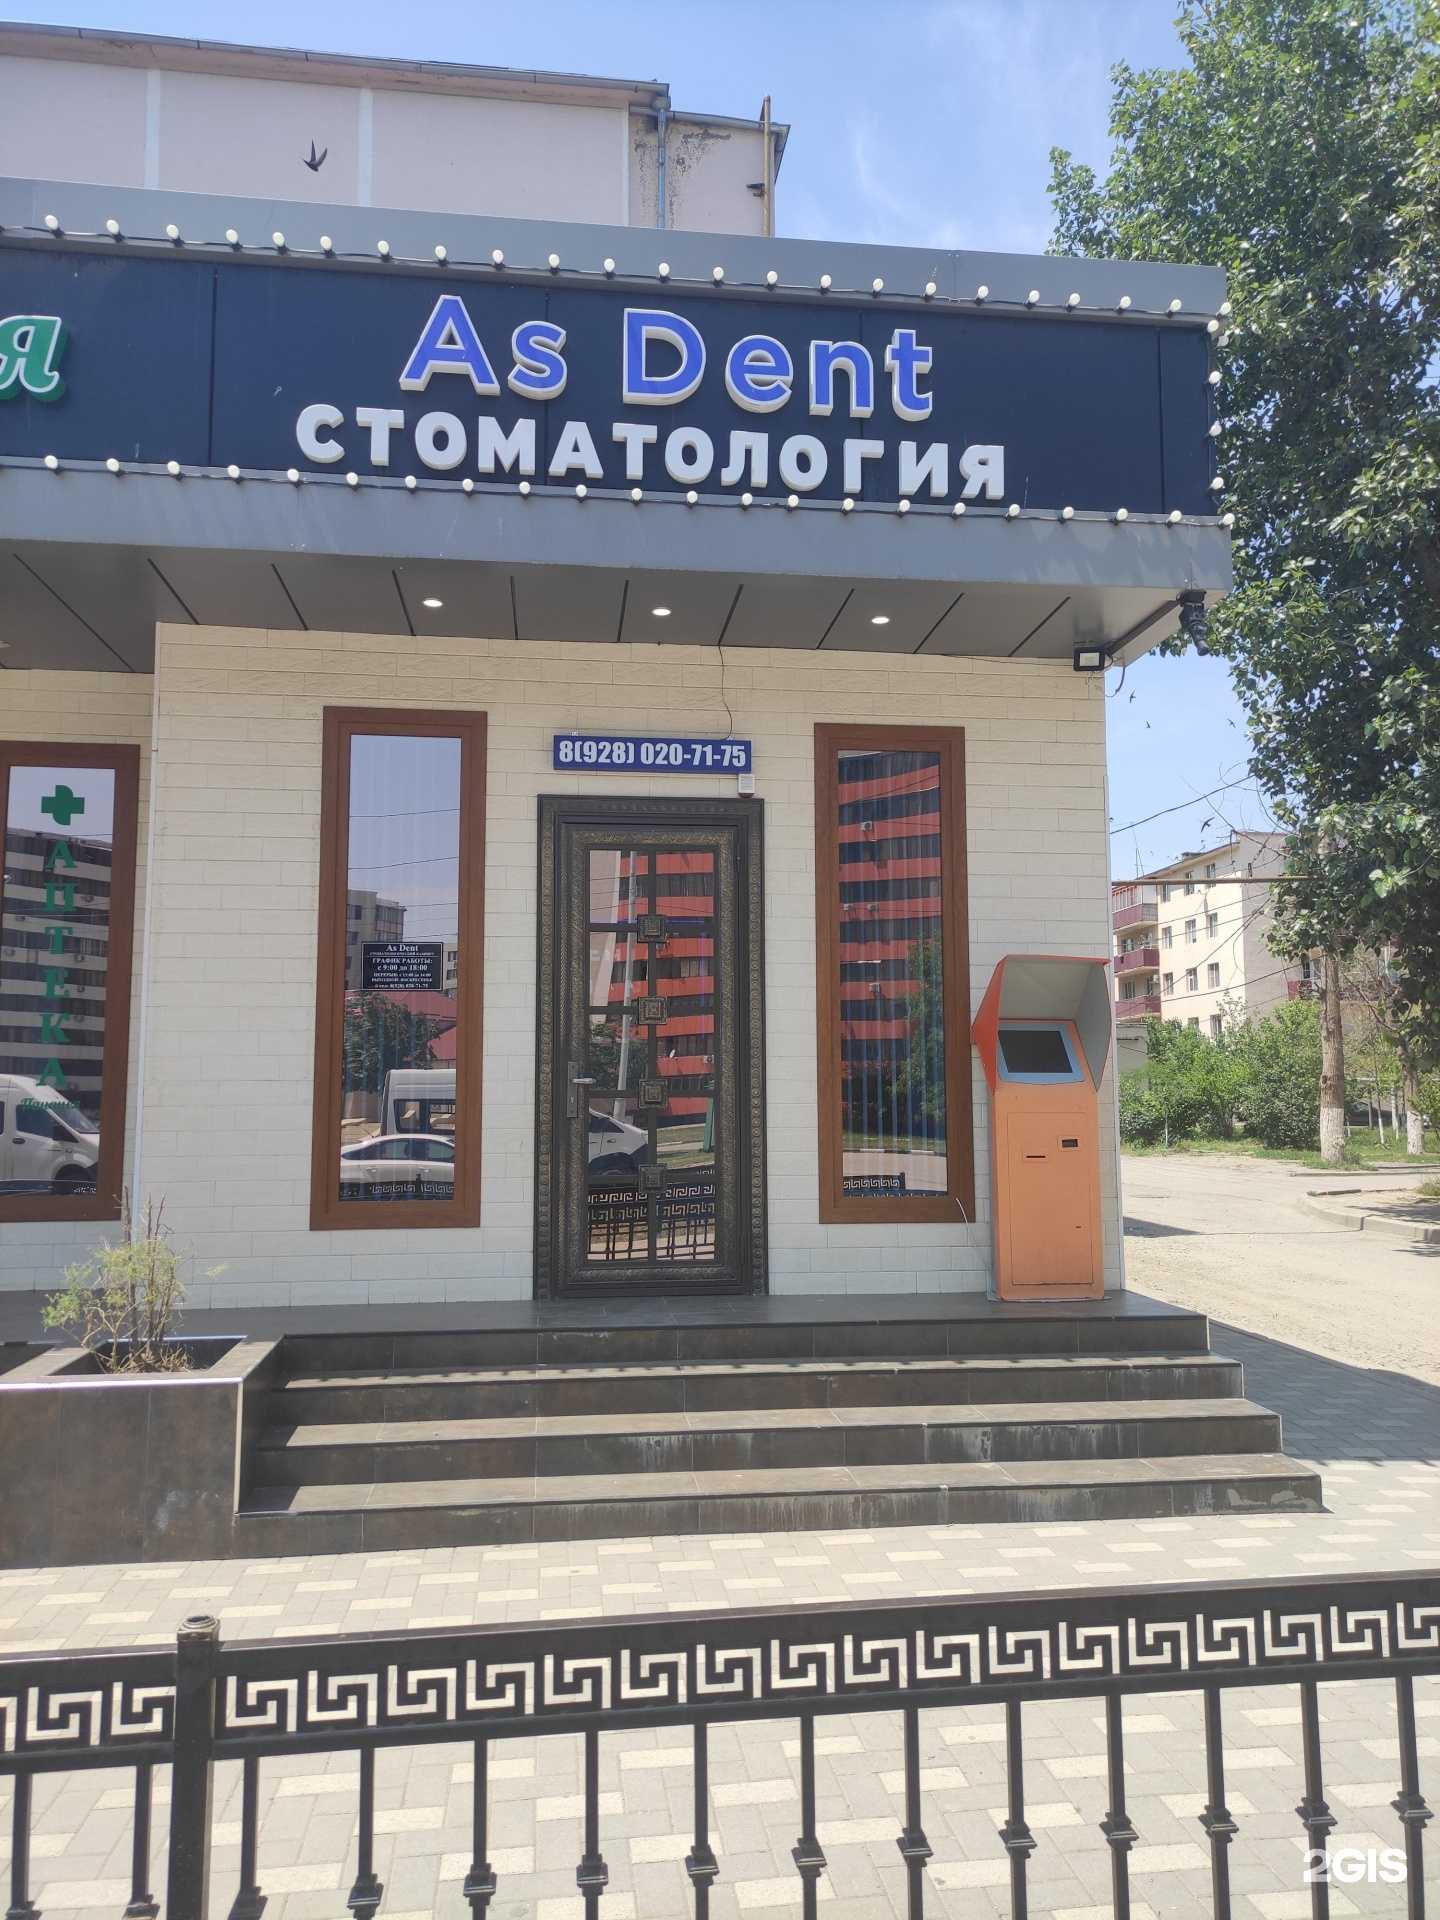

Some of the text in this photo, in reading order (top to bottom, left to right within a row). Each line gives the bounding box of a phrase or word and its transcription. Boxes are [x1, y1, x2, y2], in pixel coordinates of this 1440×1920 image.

[399, 294, 934, 422] As Dent
[296, 403, 1005, 500] СТОМАТОЛОГИЯ
[559, 740, 747, 767] 8(928) 020-71-75
